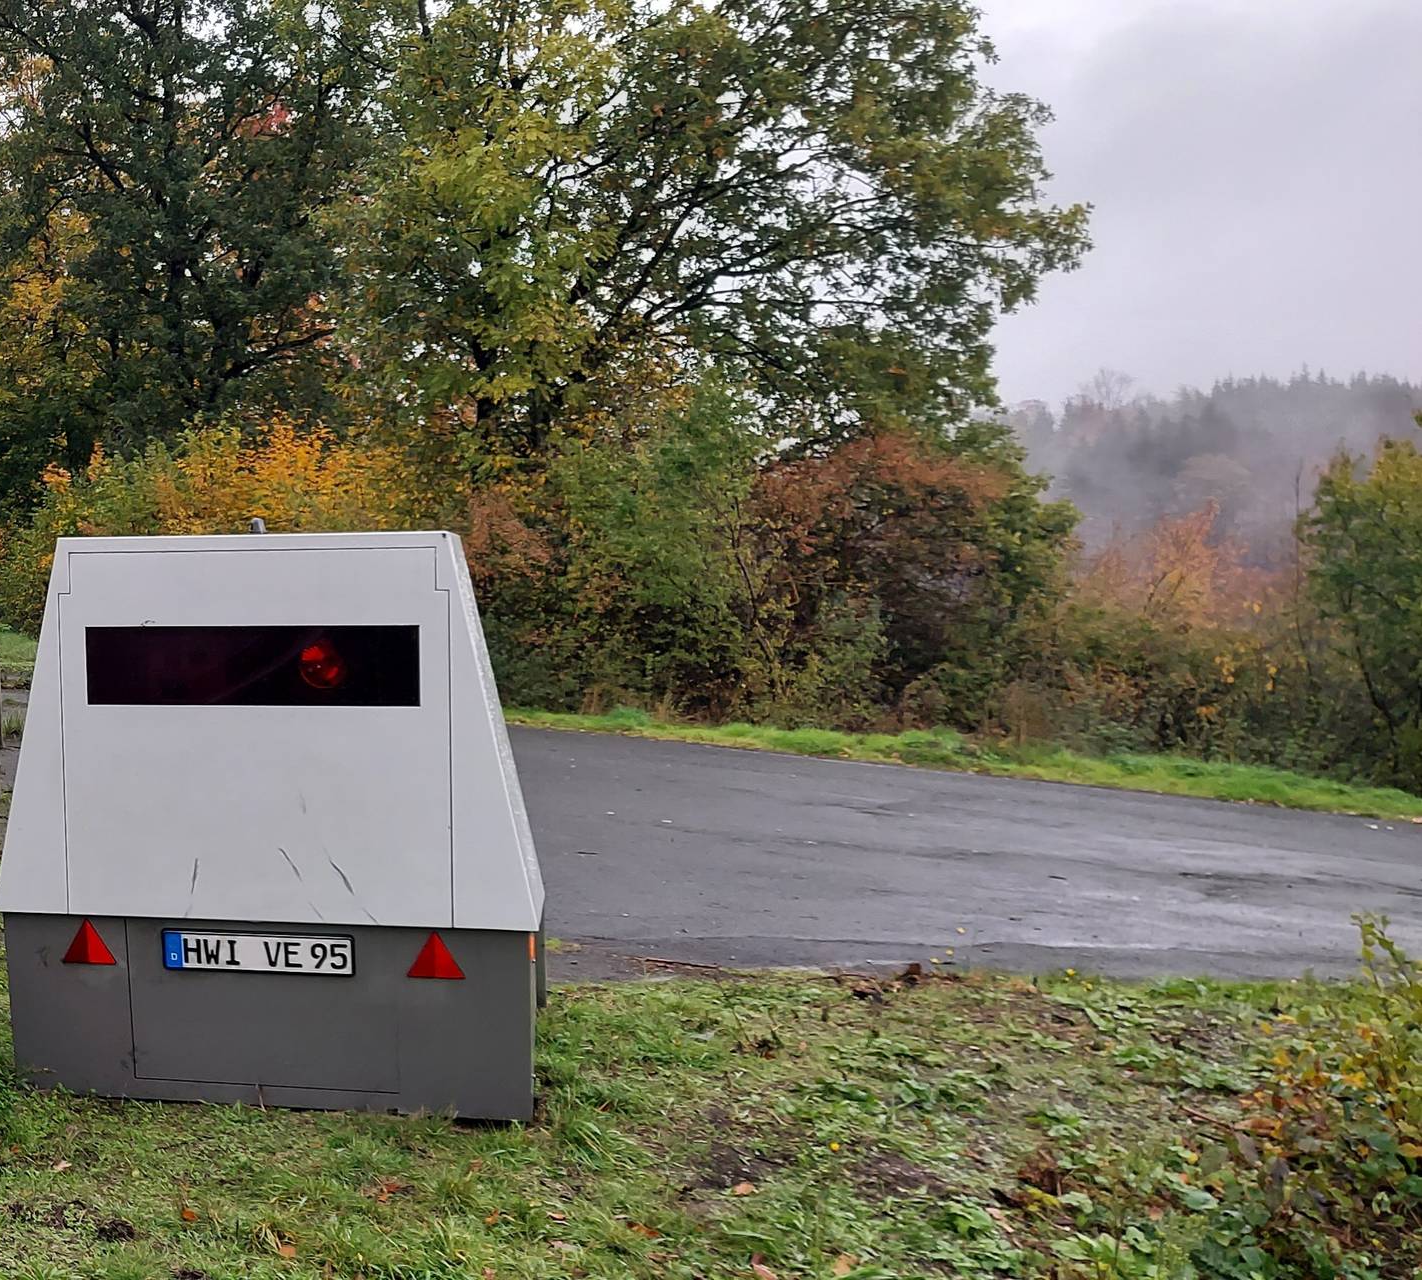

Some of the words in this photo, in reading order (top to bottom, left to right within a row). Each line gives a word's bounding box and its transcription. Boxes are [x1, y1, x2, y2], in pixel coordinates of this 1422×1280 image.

[170, 953, 178, 961] D
[183, 938, 241, 966] HWI
[263, 941, 303, 968] VE
[310, 943, 348, 970] 95
